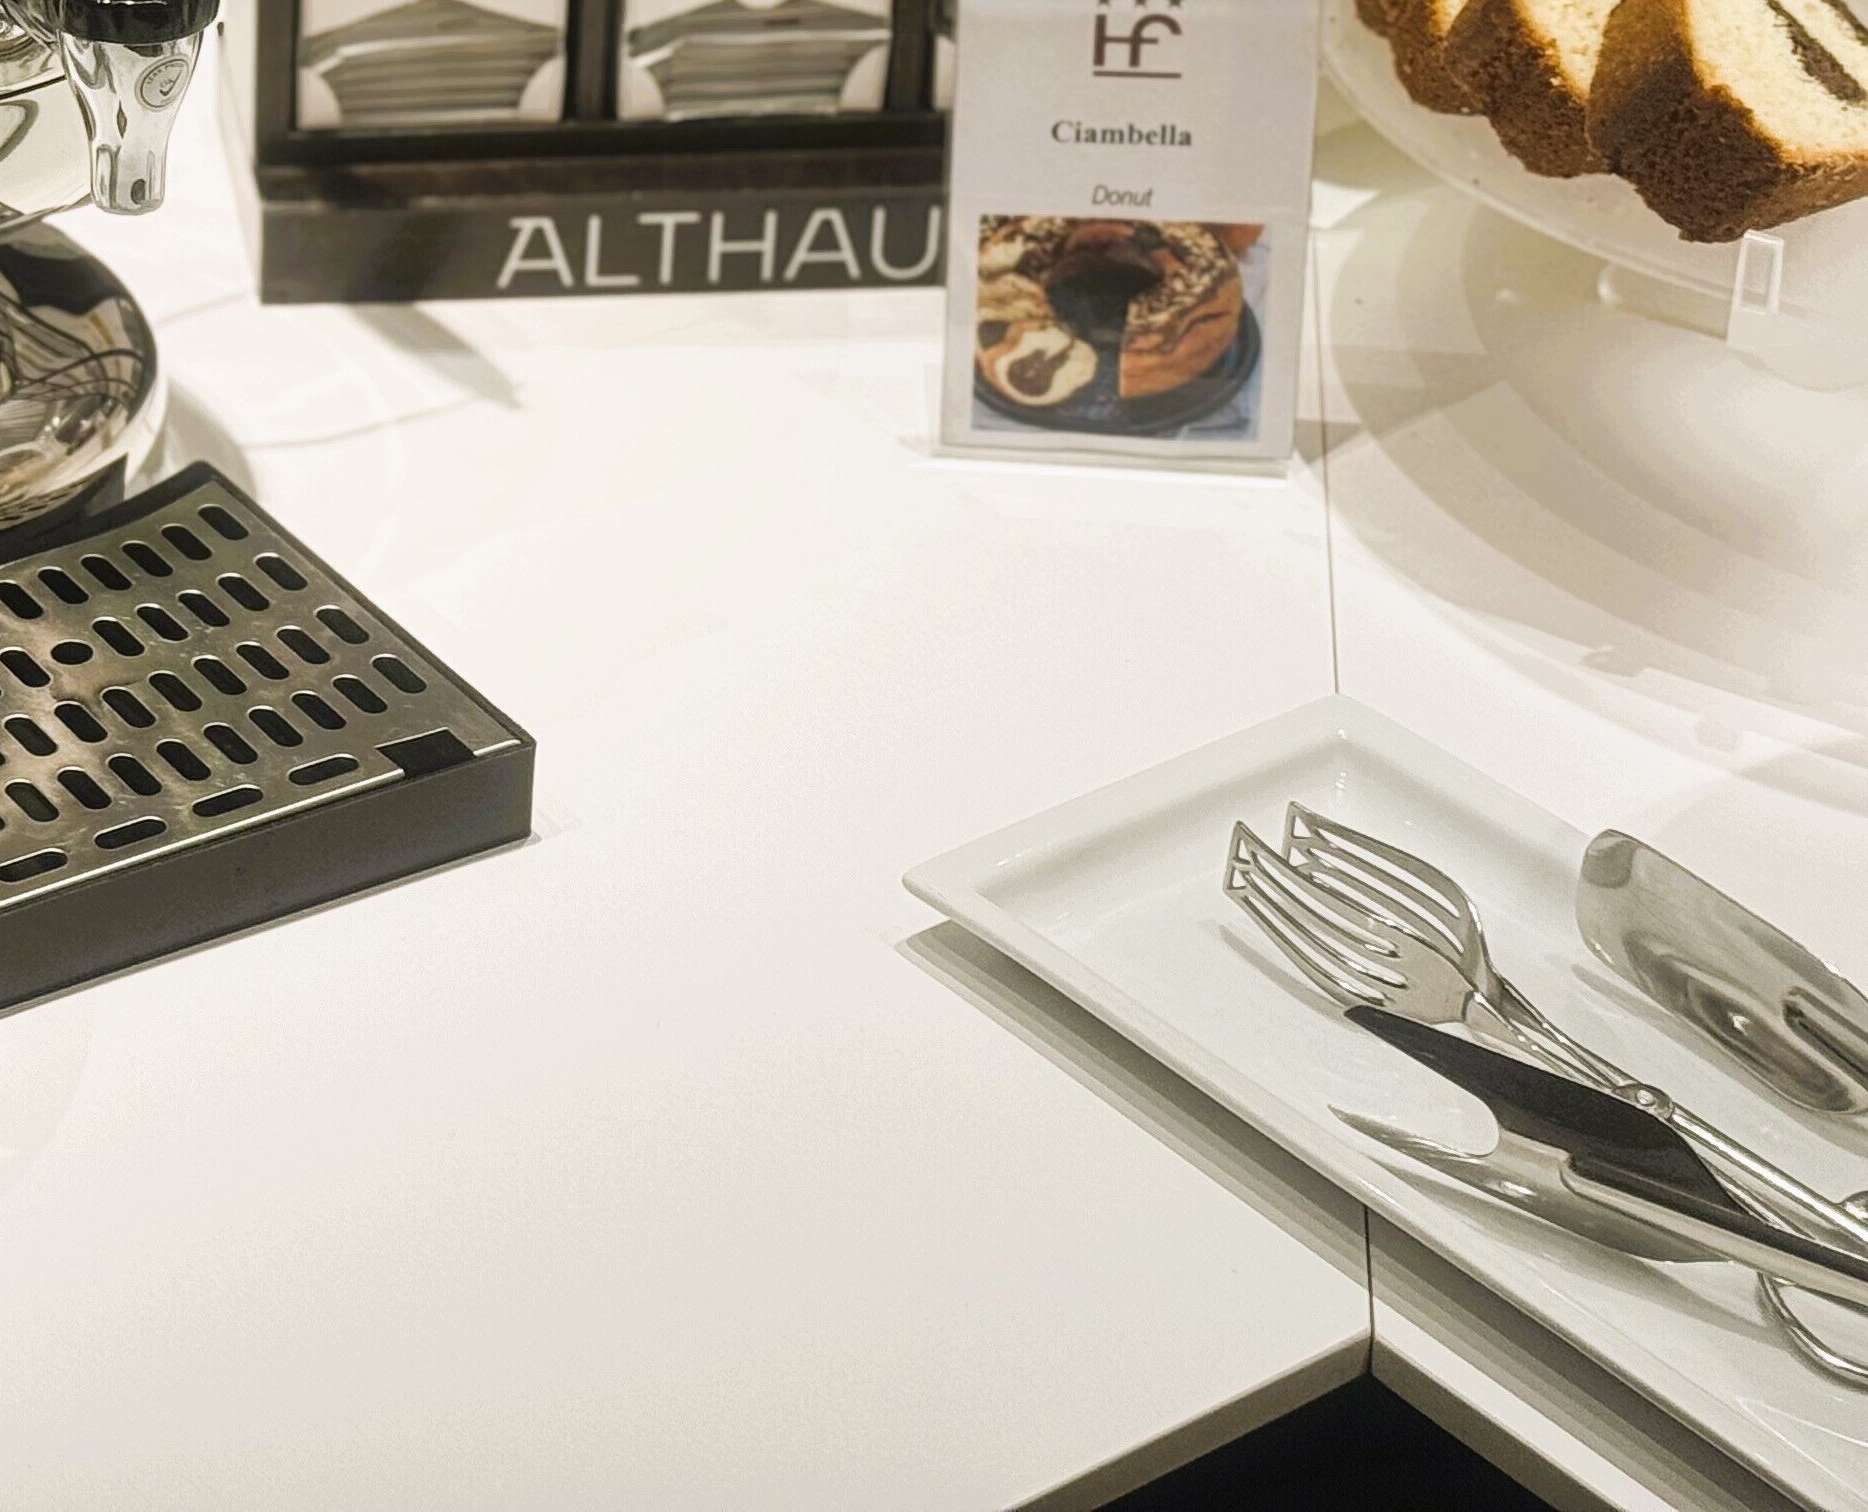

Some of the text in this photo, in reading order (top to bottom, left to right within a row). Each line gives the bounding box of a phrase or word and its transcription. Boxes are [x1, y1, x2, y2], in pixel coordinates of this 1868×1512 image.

[1052, 120, 1192, 148] Ciambella
[1092, 185, 1153, 208] Donut
[497, 205, 942, 289] ALTHAU
